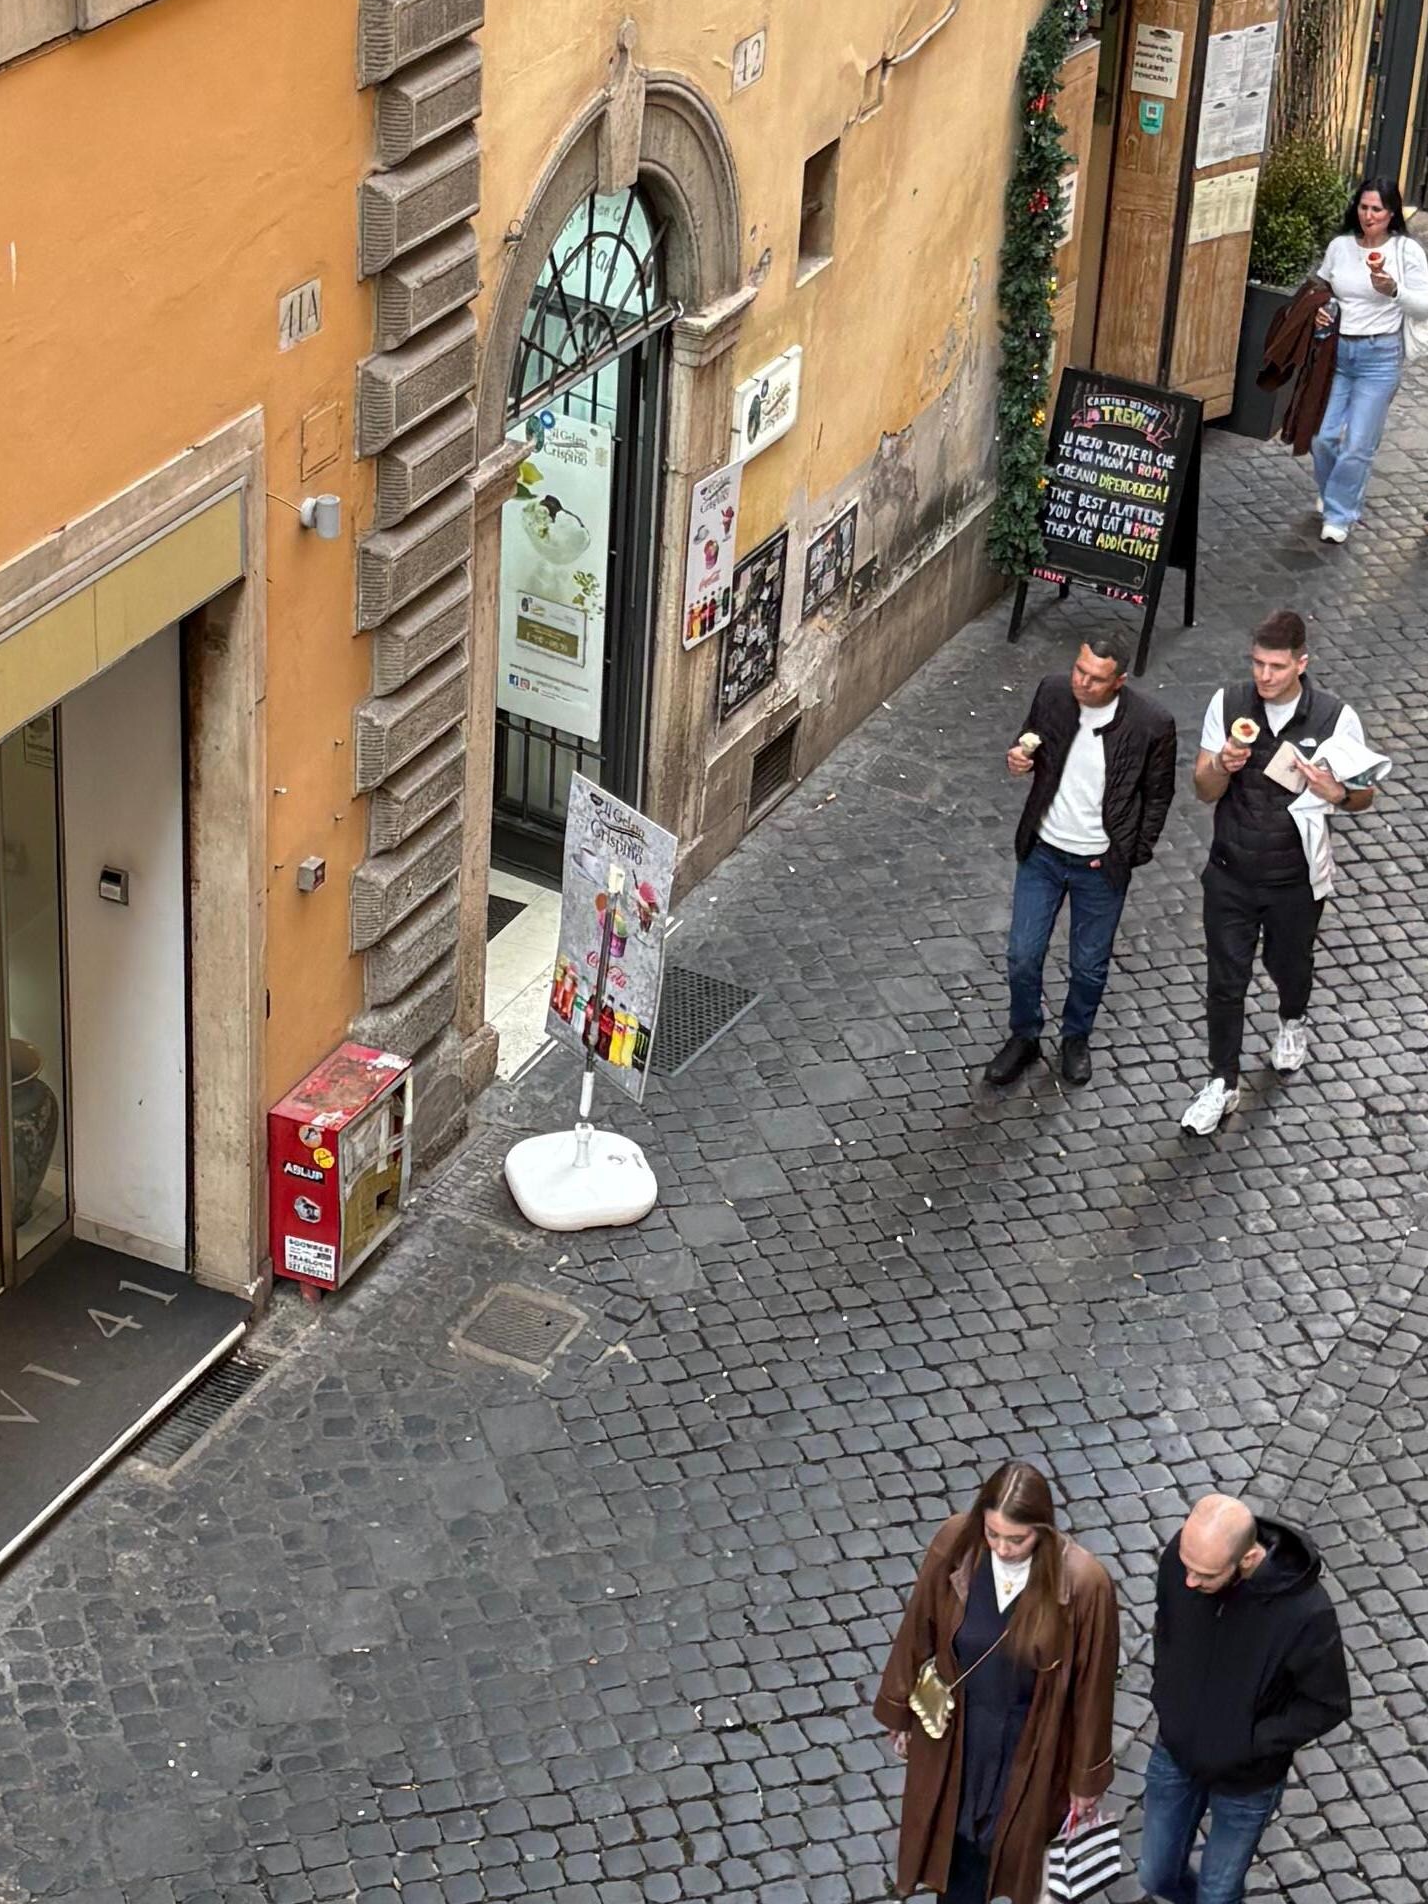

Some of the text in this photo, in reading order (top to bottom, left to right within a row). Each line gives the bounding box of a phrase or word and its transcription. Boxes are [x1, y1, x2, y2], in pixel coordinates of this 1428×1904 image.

[736, 39, 762, 81] 42
[1059, 444, 1071, 458] TE
[1136, 464, 1169, 481] ROMA
[1076, 435, 1103, 449] MEJO
[1156, 453, 1176, 470] CHE
[1056, 463, 1097, 486] CREANO
[1048, 503, 1071, 520] YOU
[1074, 507, 1099, 529] CAN
[1102, 514, 1122, 531] EAT
[1131, 521, 1162, 542] ROME
[1050, 486, 1165, 526] THE BEST PLATTERS
[1044, 519, 1159, 562] THEY'RE ADDICTIVE!
[590, 818, 643, 866] Crispino
[87, 1280, 178, 1338] 41
